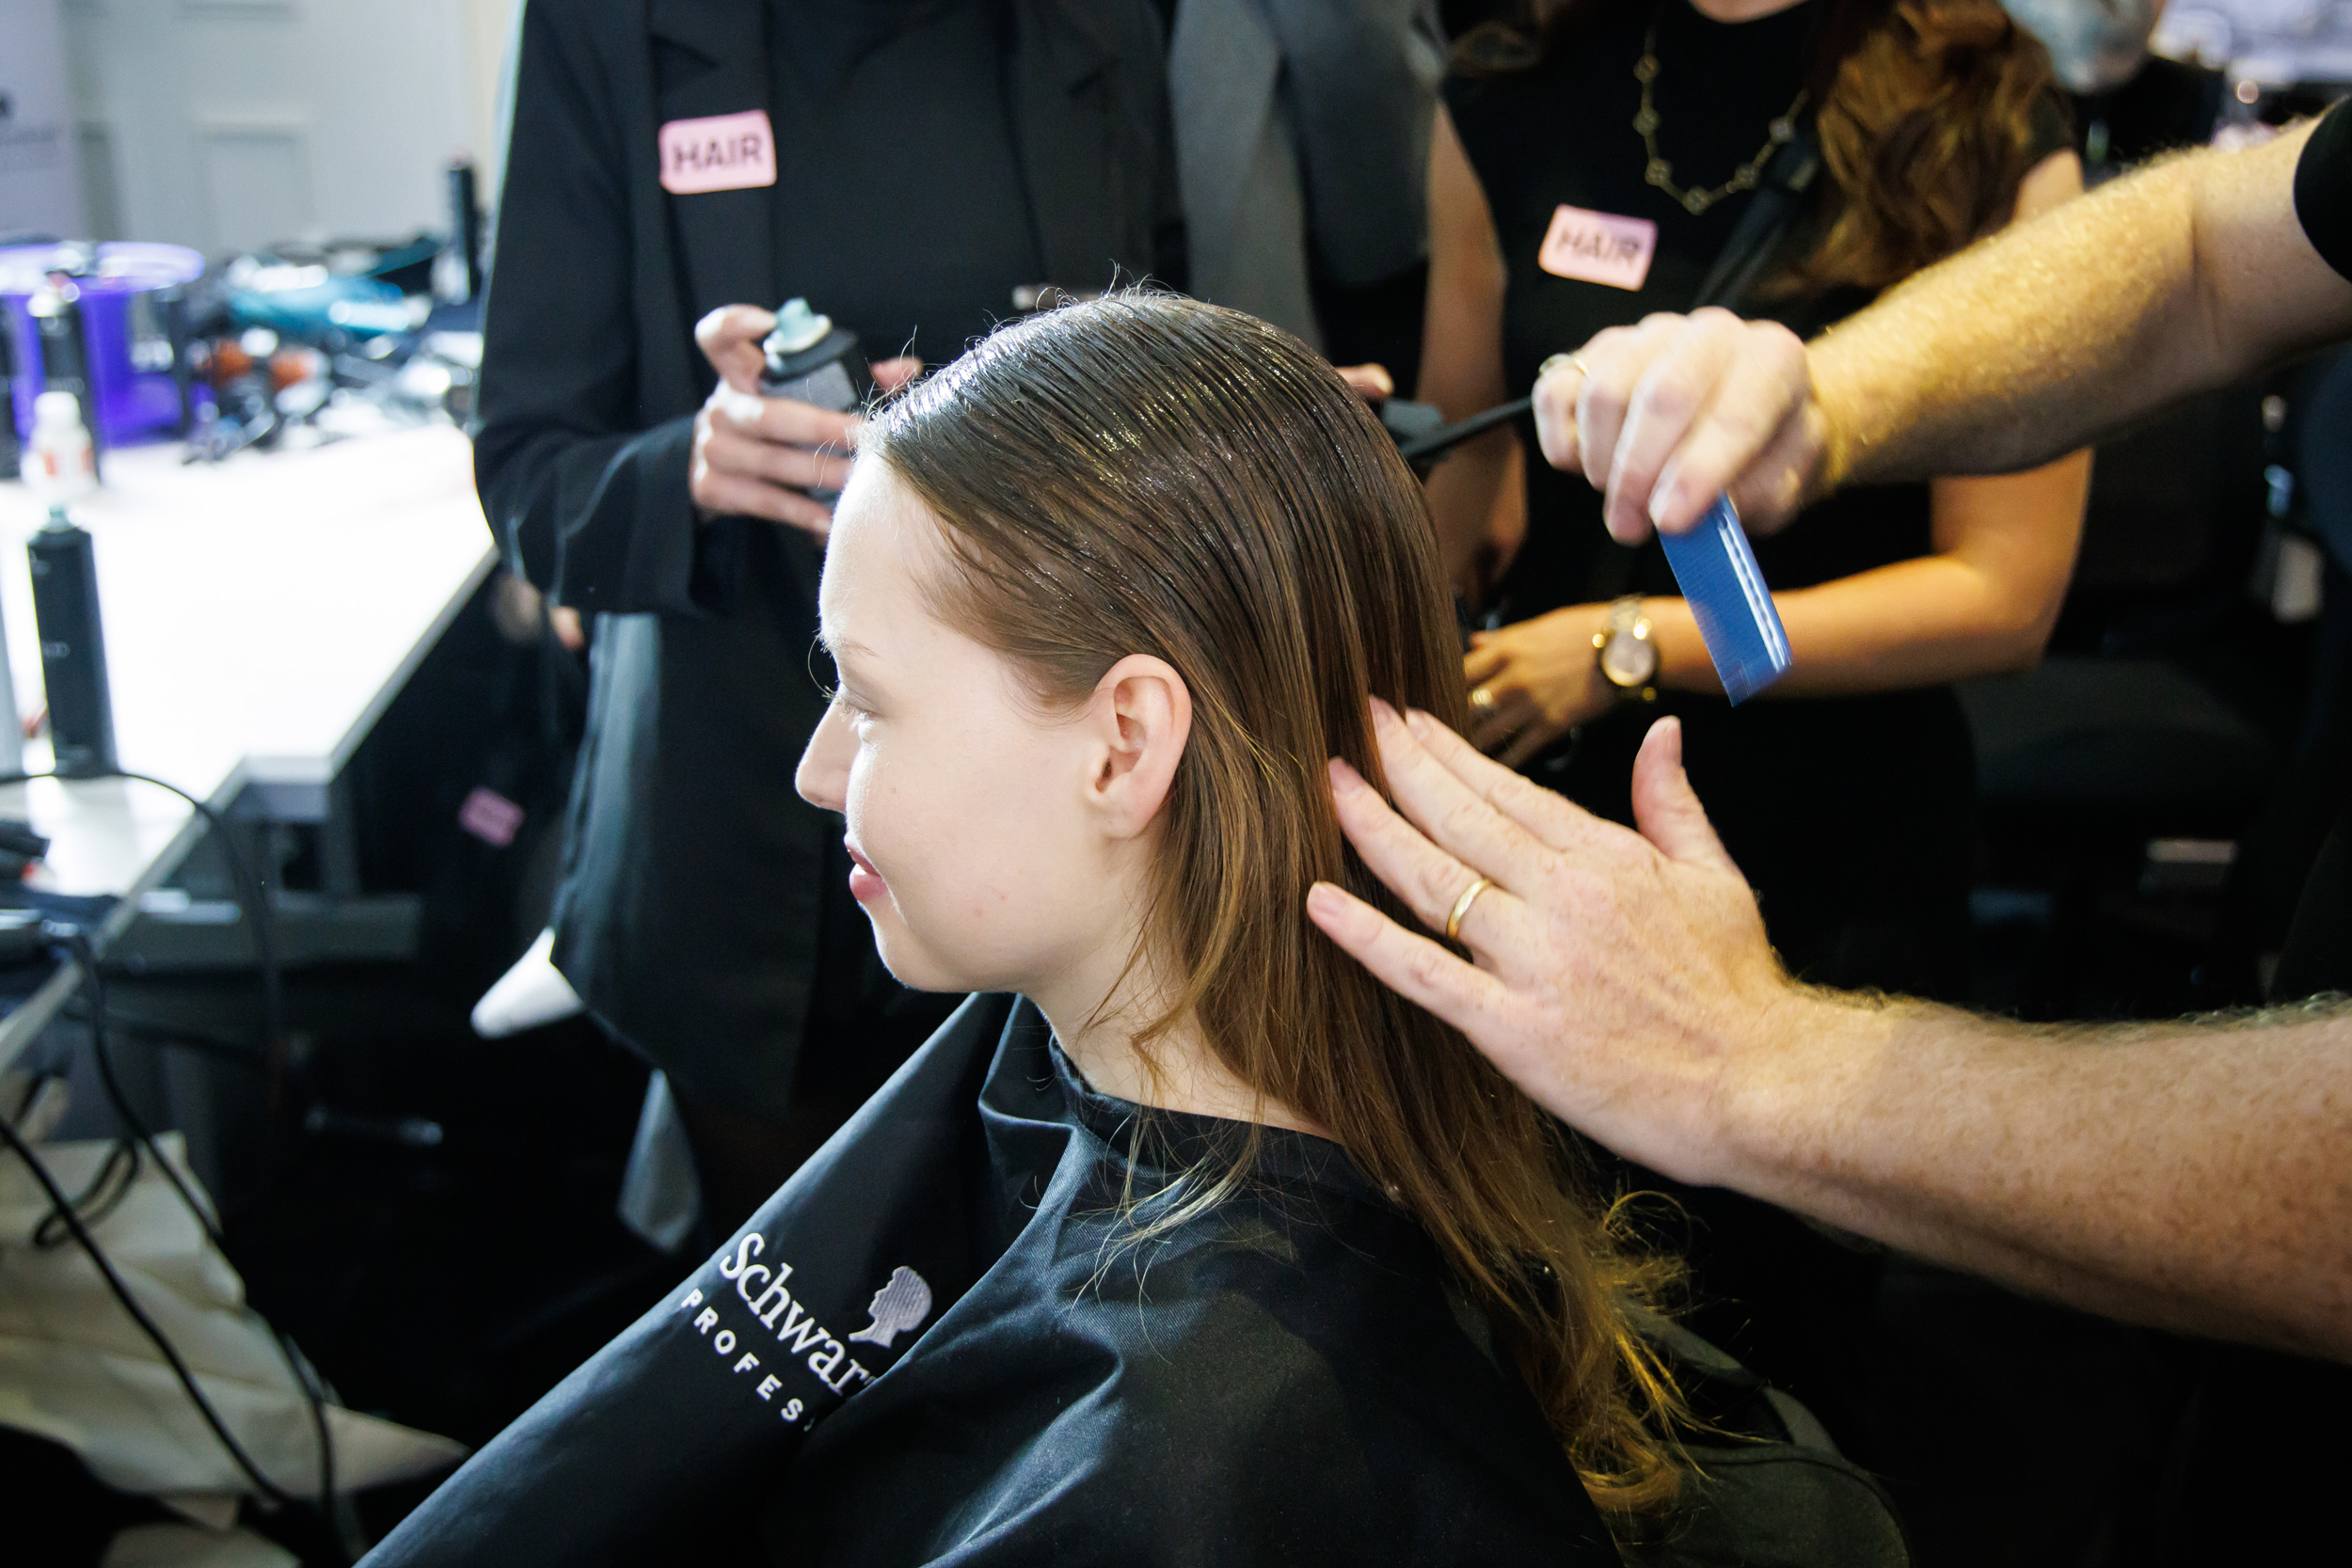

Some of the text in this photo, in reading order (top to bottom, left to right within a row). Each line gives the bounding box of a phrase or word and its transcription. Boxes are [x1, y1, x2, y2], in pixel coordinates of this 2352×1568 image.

[673, 133, 763, 174] HAIR
[1555, 227, 1642, 269] HAIR
[680, 1288, 817, 1432] PROFES
[719, 1232, 877, 1397] Schwar
